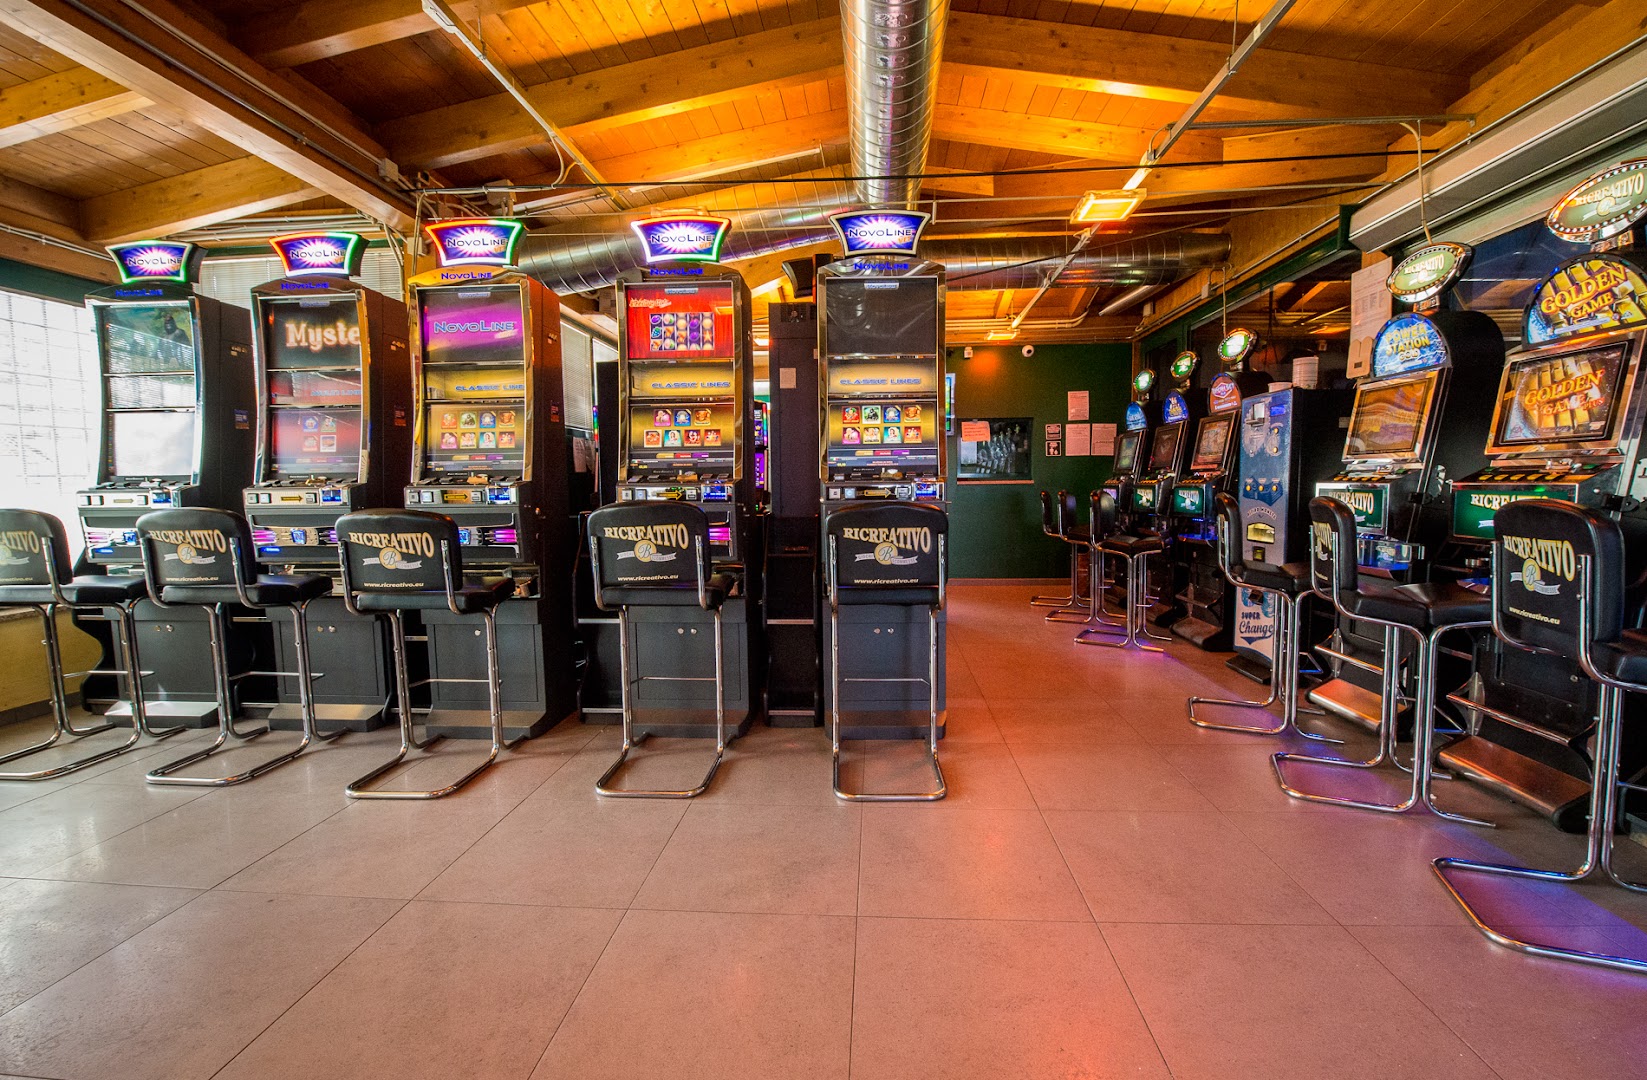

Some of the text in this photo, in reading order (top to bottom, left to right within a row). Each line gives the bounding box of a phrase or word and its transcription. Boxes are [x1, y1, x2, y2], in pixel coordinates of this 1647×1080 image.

[1575, 172, 1645, 206] RICREATIVO
[1540, 264, 1628, 315] GOLDEN
[1570, 292, 1614, 319] GAME
[285, 320, 360, 353] Myste
[434, 321, 514, 334] NOVOLINE
[1385, 324, 1428, 345] POWER
[1385, 336, 1431, 357] STATION
[1399, 349, 1421, 361] GOLD
[1524, 369, 1606, 406] GOLDEN
[1542, 393, 1587, 416] GAME
[149, 529, 227, 553] RICREATIVO
[349, 532, 434, 558] RICREATIVO
[604, 523, 689, 549] RICREATIVO
[843, 527, 931, 554] RICREATIVO
[1503, 535, 1576, 582] RICREATIVO
[617, 574, 679, 582] www.ricreativo.eu
[1241, 611, 1261, 620] SUPER
[1509, 606, 1561, 625] www.ricreativo.eu
[1239, 621, 1275, 638] Change
